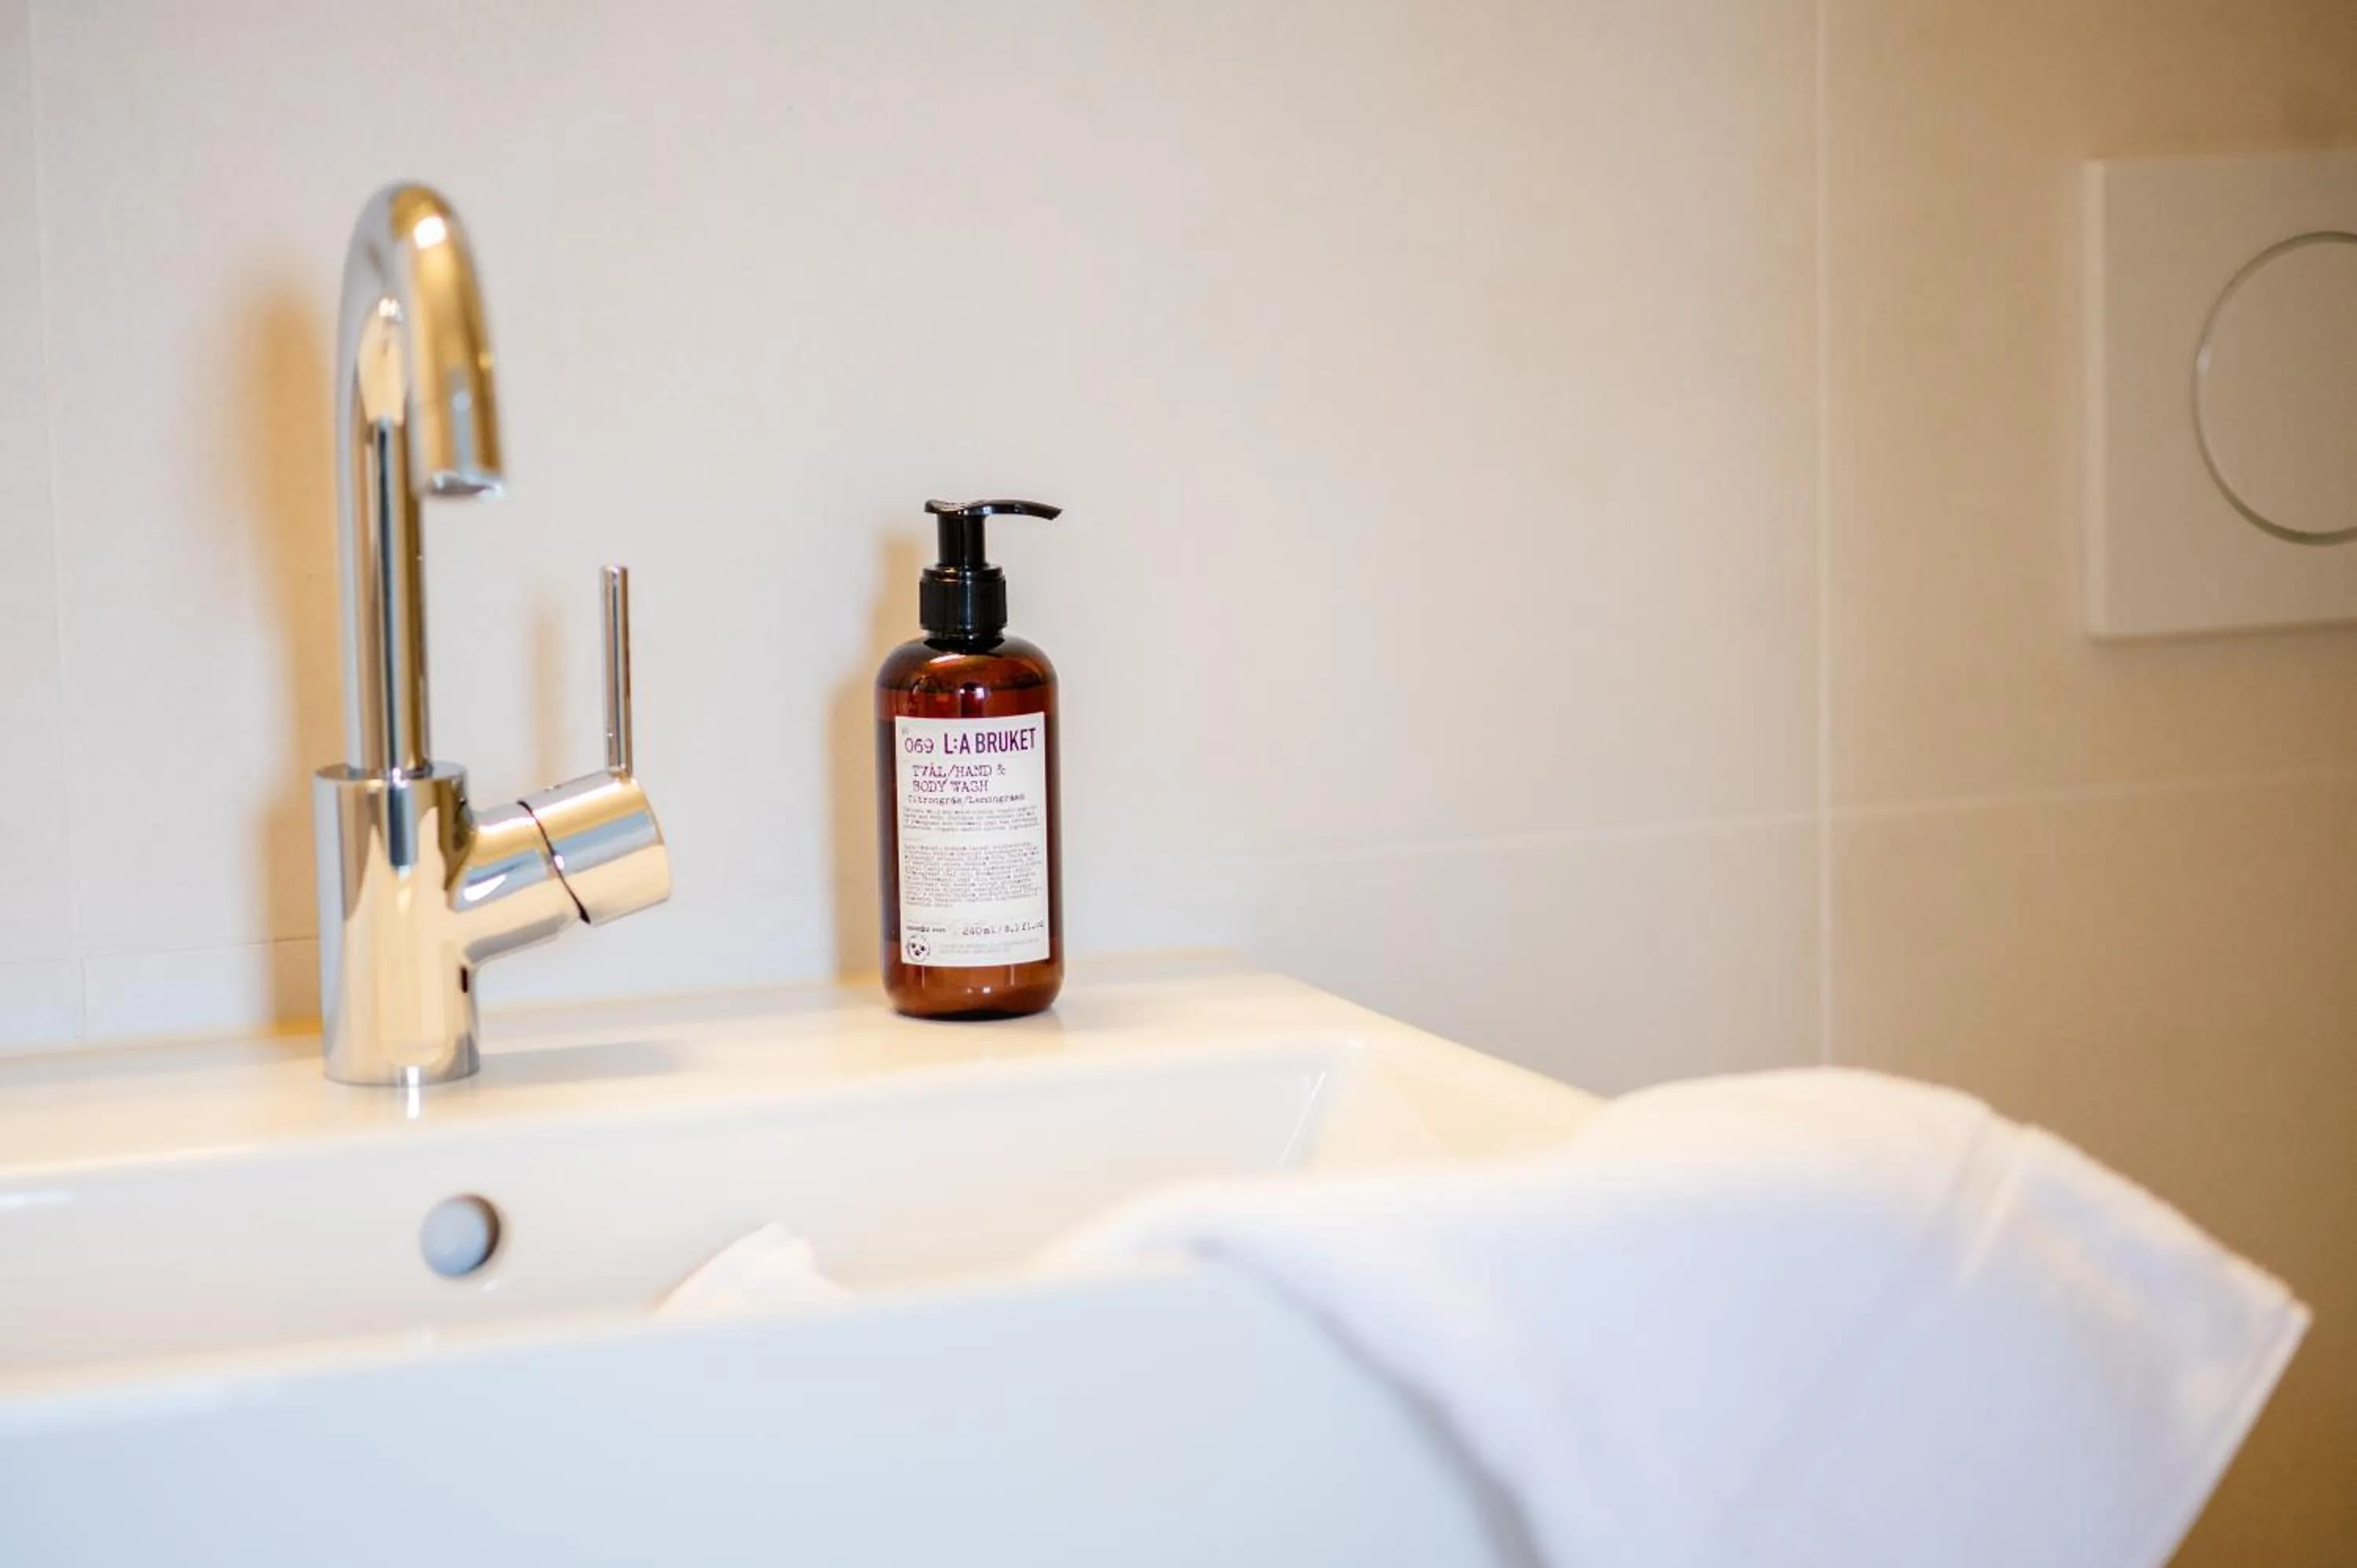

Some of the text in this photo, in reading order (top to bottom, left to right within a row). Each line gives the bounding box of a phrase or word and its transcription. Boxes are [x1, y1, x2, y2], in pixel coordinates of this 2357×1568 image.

[904, 727, 1036, 755] 069 L:A BRUKET
[997, 764, 1006, 776] &
[912, 779, 988, 793] BODY WASH
